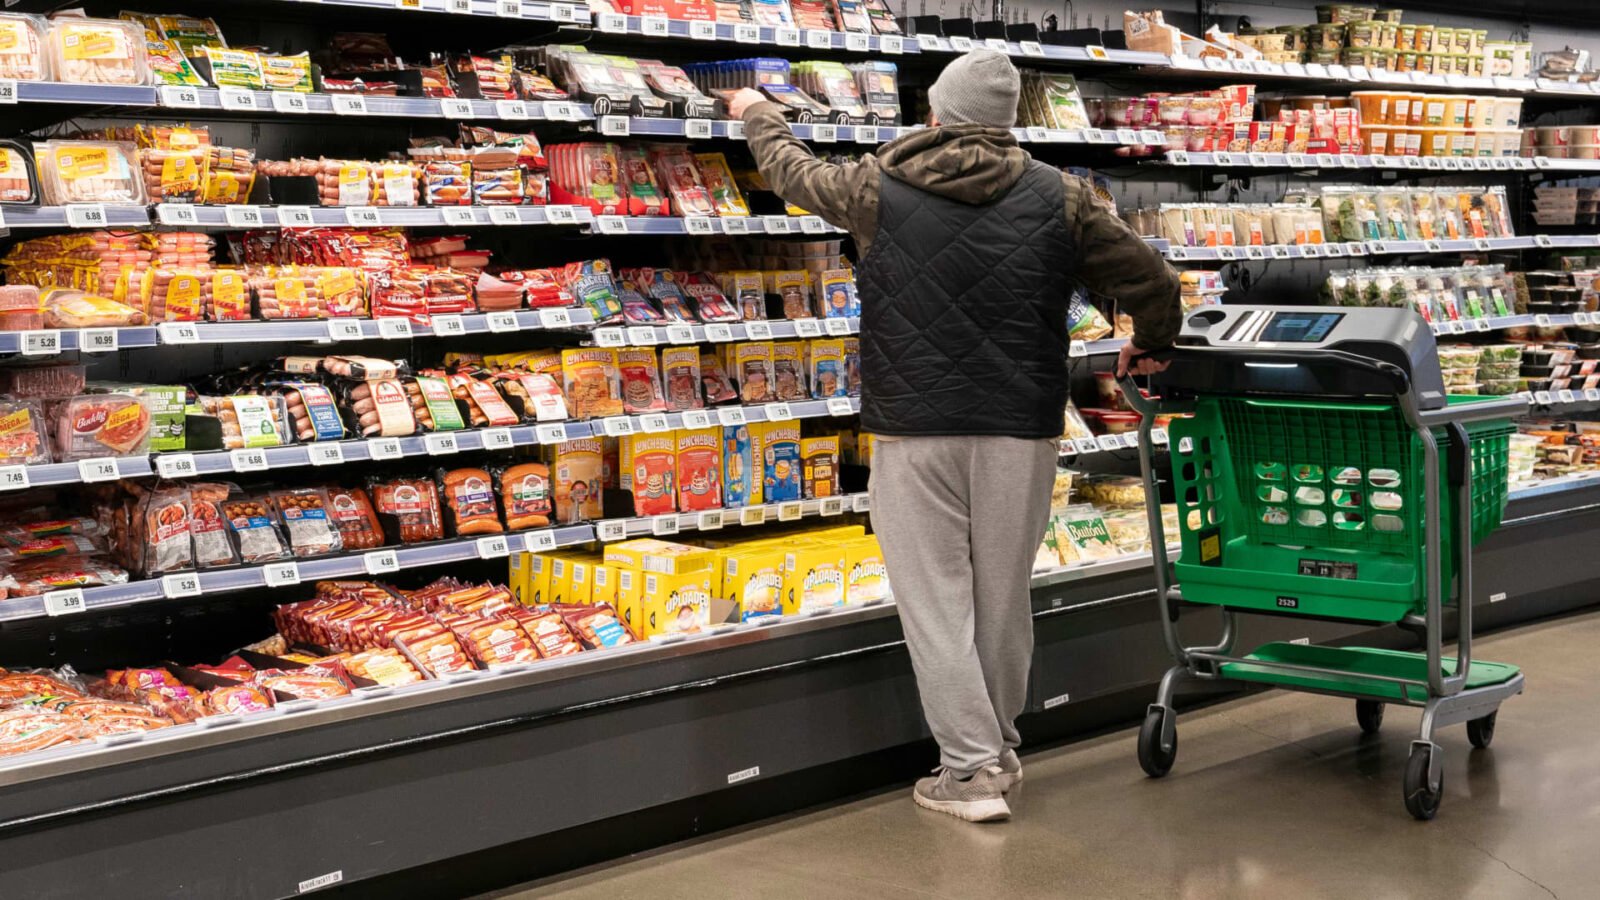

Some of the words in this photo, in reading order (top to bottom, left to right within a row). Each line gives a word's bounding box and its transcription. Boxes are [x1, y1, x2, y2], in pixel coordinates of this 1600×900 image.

[0, 87, 12, 96] .28
[181, 92, 194, 101] 6.29
[238, 94, 251, 104] 6.29
[290, 97, 302, 107] 6.29
[85, 211, 101, 221] 6.88
[244, 212, 257, 221] 5.79
[295, 212, 308, 221] 6.79
[577, 275, 611, 293] CRACKER
[1071, 304, 1087, 322] SIZE
[180, 329, 193, 338] 5.79
[345, 326, 358, 335] 6.79
[41, 338, 55, 347] 5.28
[95, 336, 112, 346] 10.99
[567, 352, 612, 366] LUNCHABLES
[666, 352, 696, 364] LUNCHABLES
[2, 417, 20, 429] MEGA
[77, 411, 106, 429] Buddig
[110, 416, 130, 425] MEGA
[498, 435, 508, 443] 5.99
[765, 429, 801, 443] LUNCHABLES
[441, 440, 453, 449] 5.99
[559, 439, 601, 455] LUNCHABLES
[636, 438, 673, 454] LUNCHABLES
[680, 435, 717, 449] LUNCHABLES
[809, 440, 836, 453] LUNCHABLES
[326, 450, 338, 459] 5.99
[385, 445, 397, 454] 5.99
[176, 461, 190, 471] 6.68
[249, 456, 262, 466] 6.68
[99, 465, 113, 475] 7.49
[7, 474, 23, 483] 7.49
[1069, 524, 1105, 542] Buitoni
[281, 570, 294, 579] 5.29
[181, 581, 195, 591] 5.29
[744, 573, 783, 592] UPLOADED
[64, 598, 80, 607] 3.99
[1278, 599, 1296, 607] 2529
